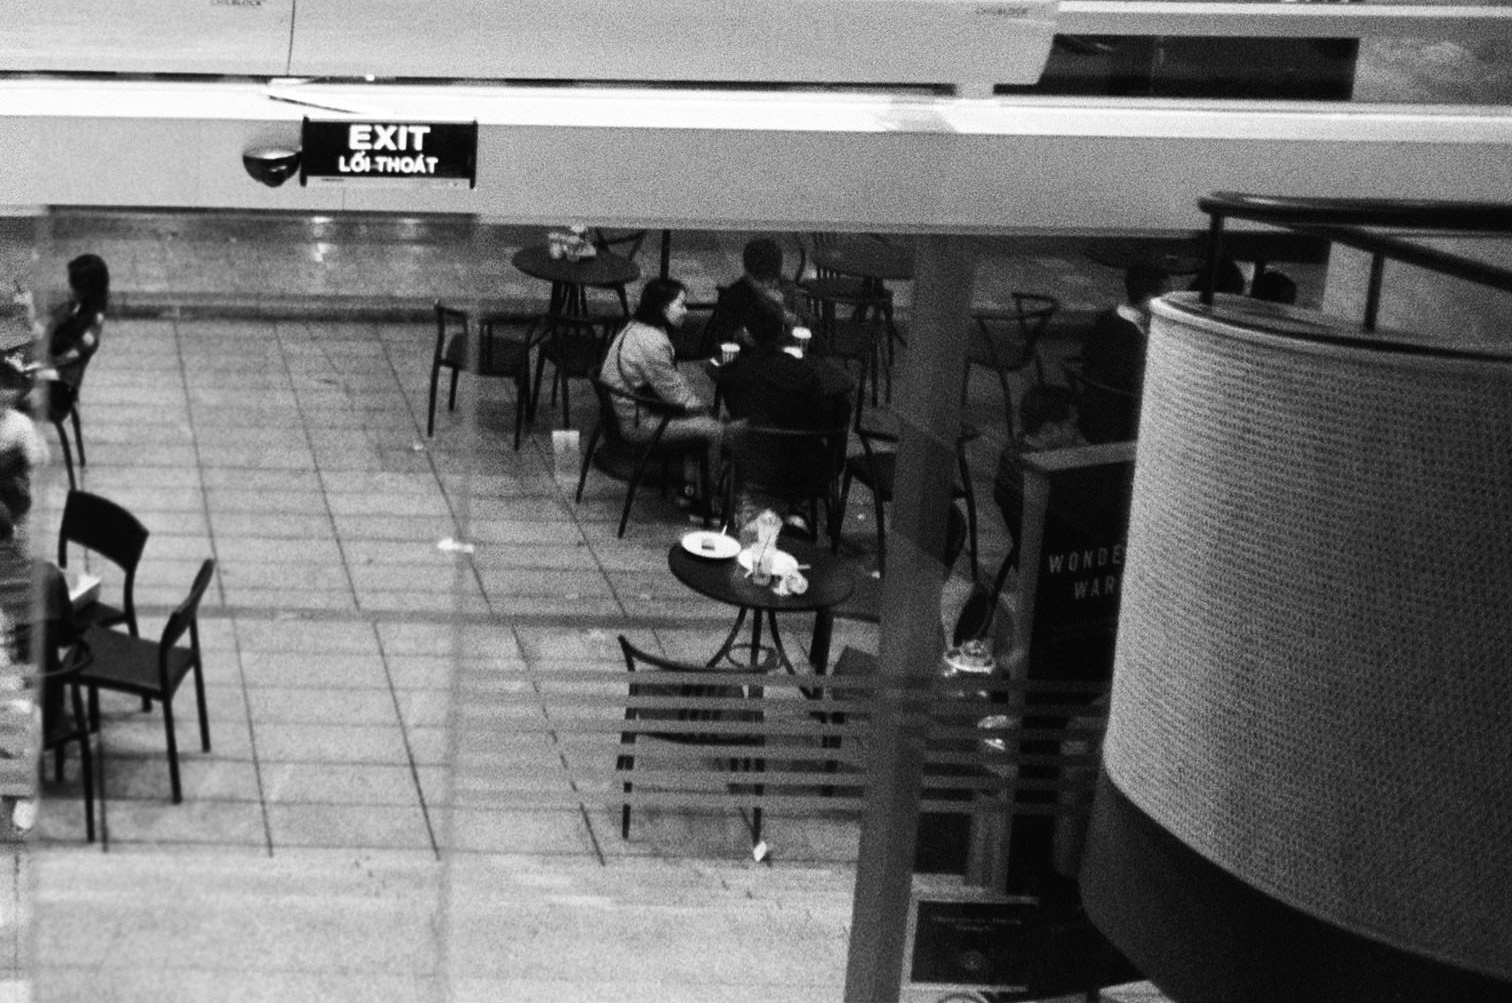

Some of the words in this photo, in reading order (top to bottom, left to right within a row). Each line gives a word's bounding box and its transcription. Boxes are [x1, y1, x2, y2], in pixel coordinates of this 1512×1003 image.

[348, 124, 431, 151] EXIT
[338, 151, 371, 172] LỐI
[375, 154, 439, 173] THOÁT
[1048, 543, 1124, 574] WONDE
